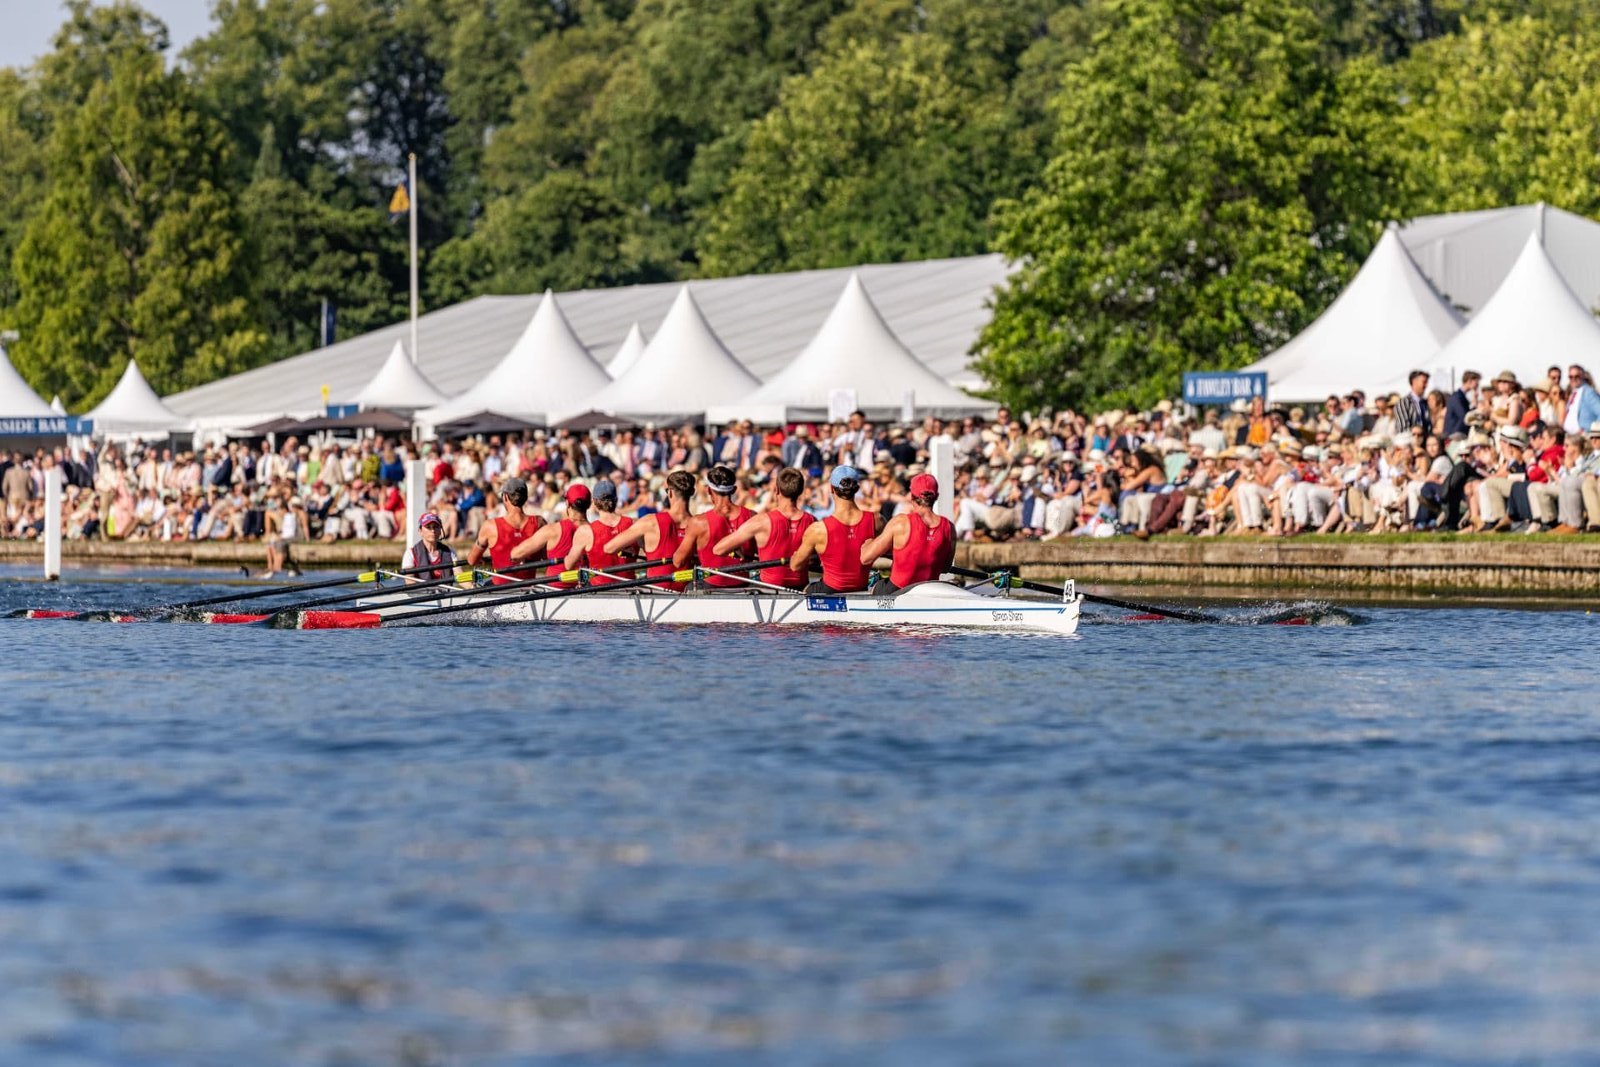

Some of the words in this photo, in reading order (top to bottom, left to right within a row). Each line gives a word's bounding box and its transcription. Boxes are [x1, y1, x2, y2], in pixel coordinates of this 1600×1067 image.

[1232, 376, 1252, 396] BAR
[0, 418, 35, 434] SIDE
[39, 418, 67, 433] BAR
